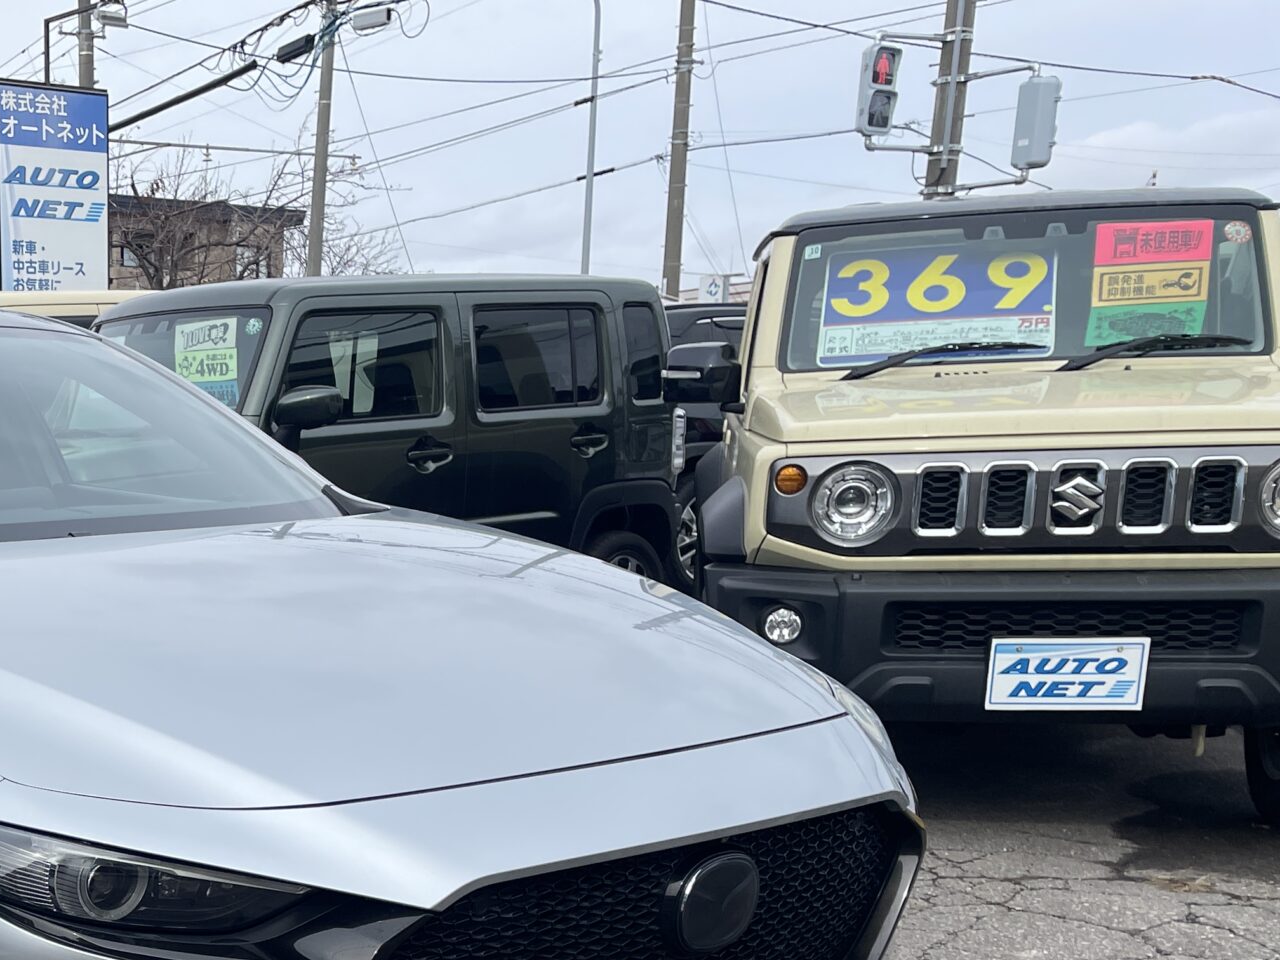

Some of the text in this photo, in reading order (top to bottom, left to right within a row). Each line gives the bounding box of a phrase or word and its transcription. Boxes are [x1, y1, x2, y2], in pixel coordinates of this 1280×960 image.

[0, 90, 68, 117] 株式会社
[1, 115, 105, 146] オートネット
[2, 165, 101, 190] AUTO
[11, 198, 84, 221] NET
[12, 258, 86, 276] 中古車リース
[13, 278, 62, 291] お気軽に
[1017, 317, 1051, 329] 万円
[187, 325, 210, 348] LOVE
[196, 358, 229, 377] 4WD
[998, 657, 1129, 675] AUTO
[1007, 681, 1107, 698] NET
